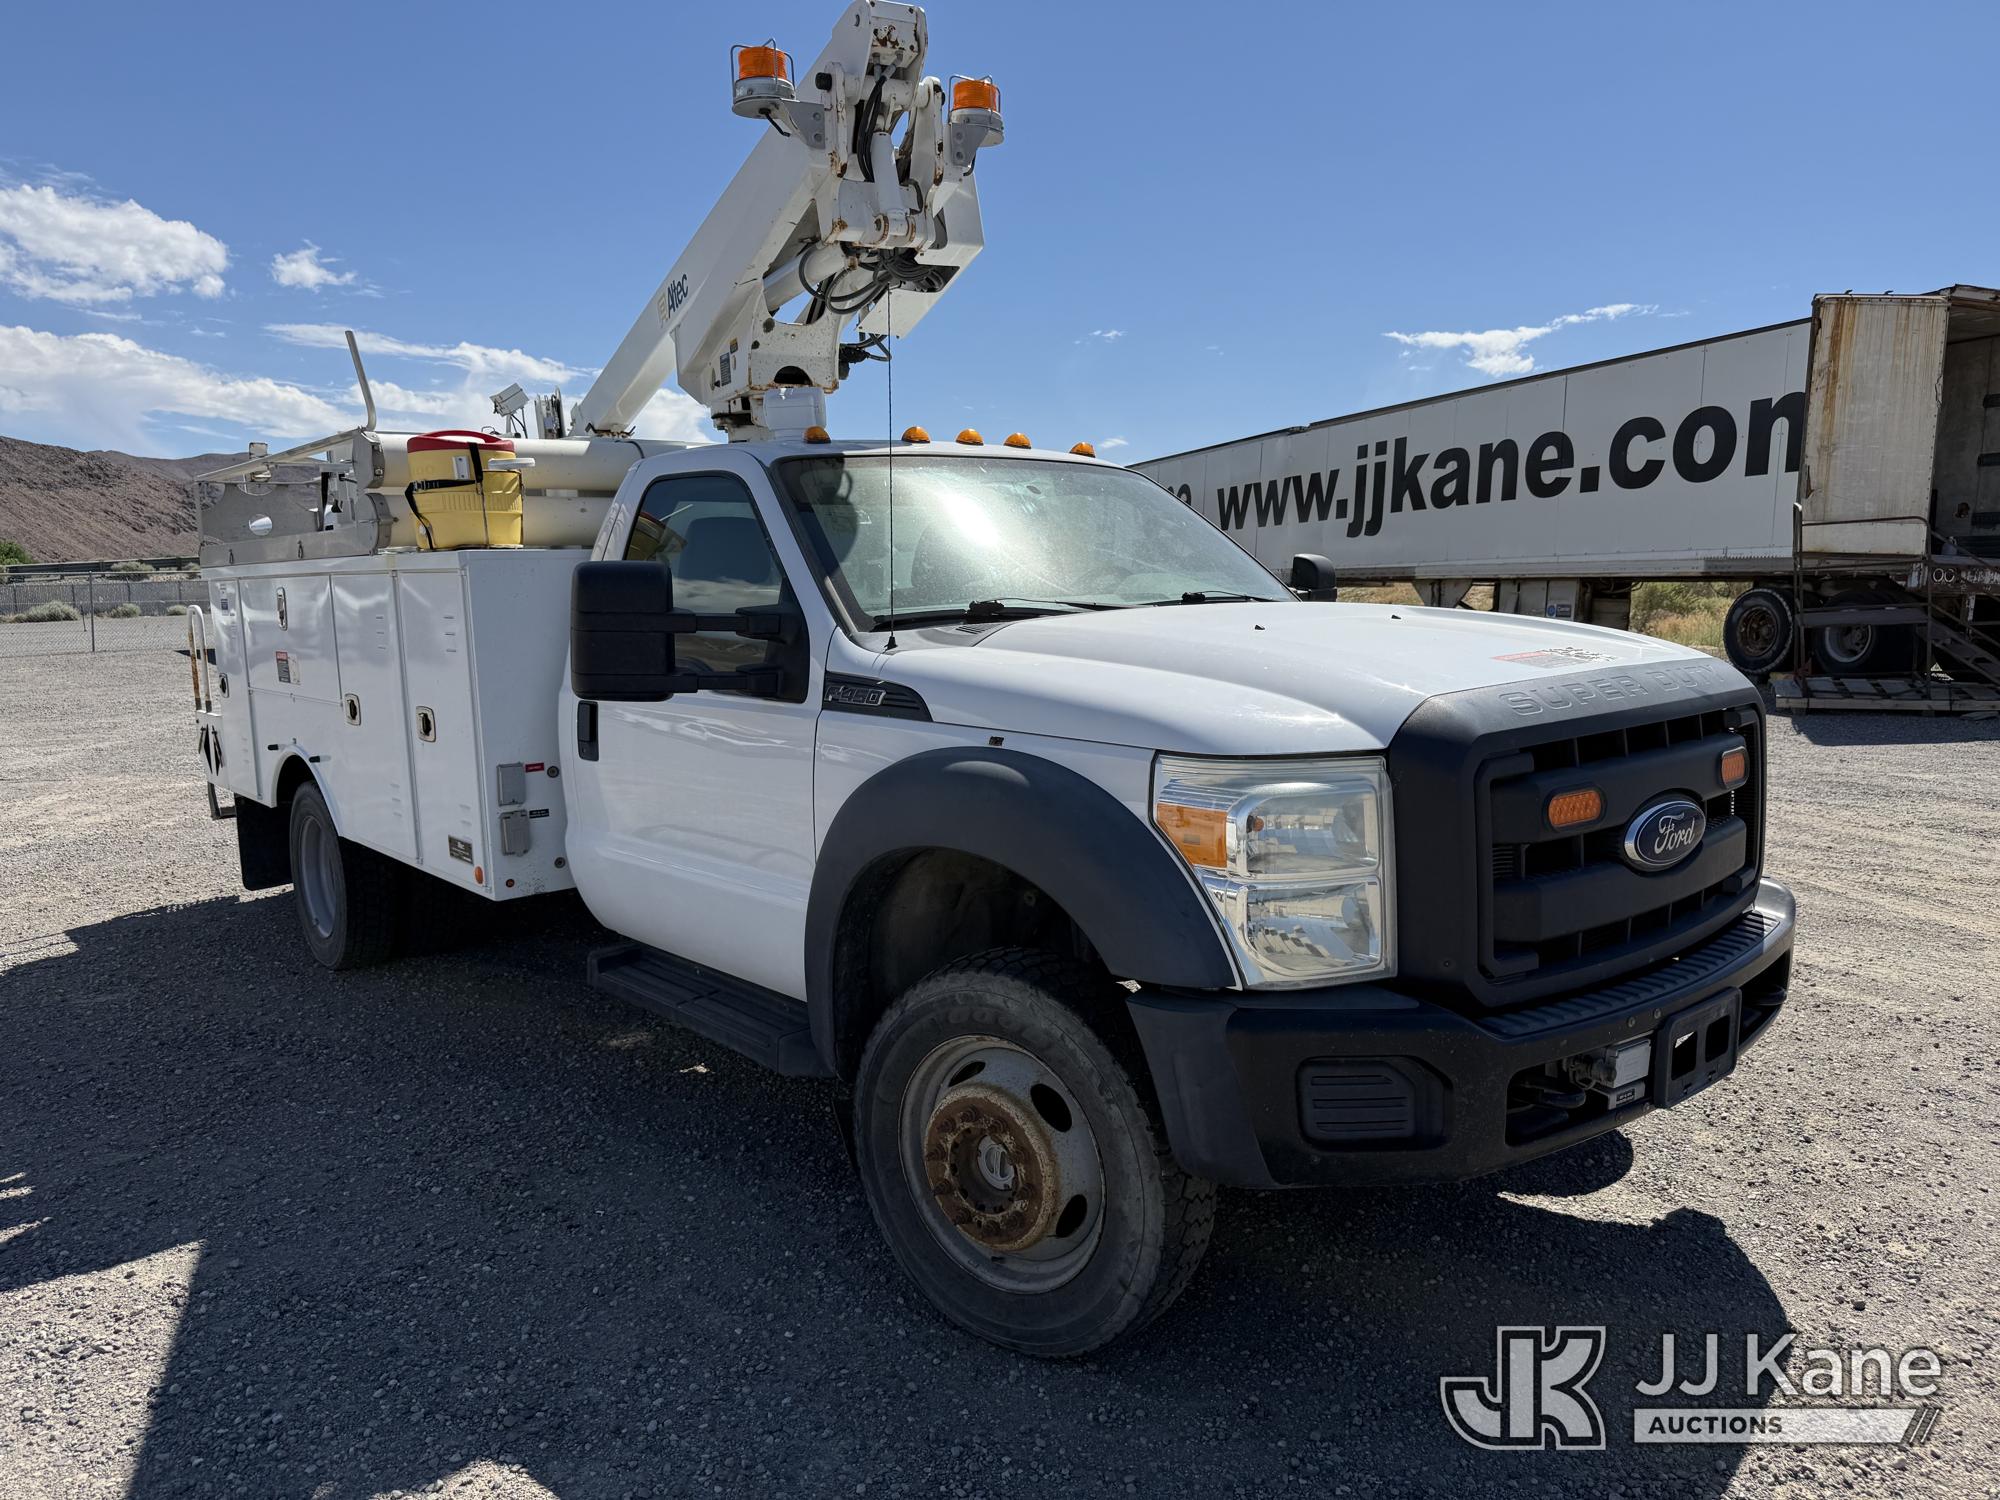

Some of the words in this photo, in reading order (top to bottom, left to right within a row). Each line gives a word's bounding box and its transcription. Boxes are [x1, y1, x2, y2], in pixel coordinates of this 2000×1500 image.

[667, 273, 689, 319] Altec
[1499, 674, 1648, 716] SUPER
[1647, 663, 1725, 692] DUTY
[1654, 811, 1696, 854] Ford
